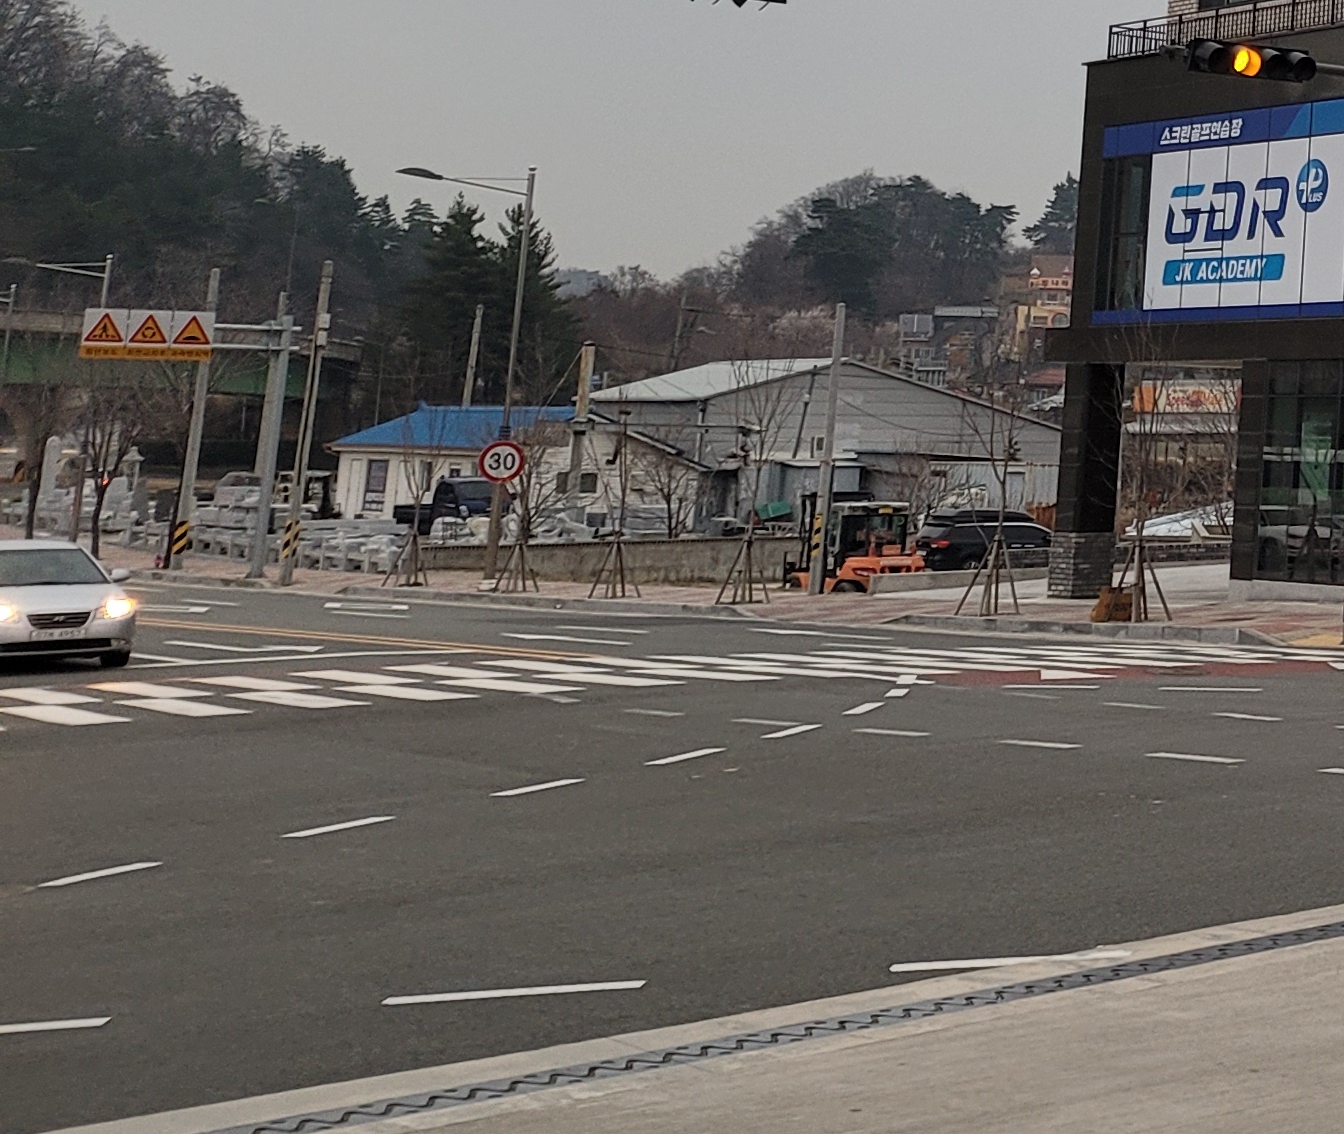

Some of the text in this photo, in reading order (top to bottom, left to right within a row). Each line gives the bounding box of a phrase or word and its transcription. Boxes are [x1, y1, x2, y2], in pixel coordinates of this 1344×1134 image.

[1159, 117, 1244, 146] 스크린골프연습장
[1164, 176, 1290, 245] GDR
[1174, 257, 1268, 283] JK ACADEMY
[487, 452, 517, 471] 30
